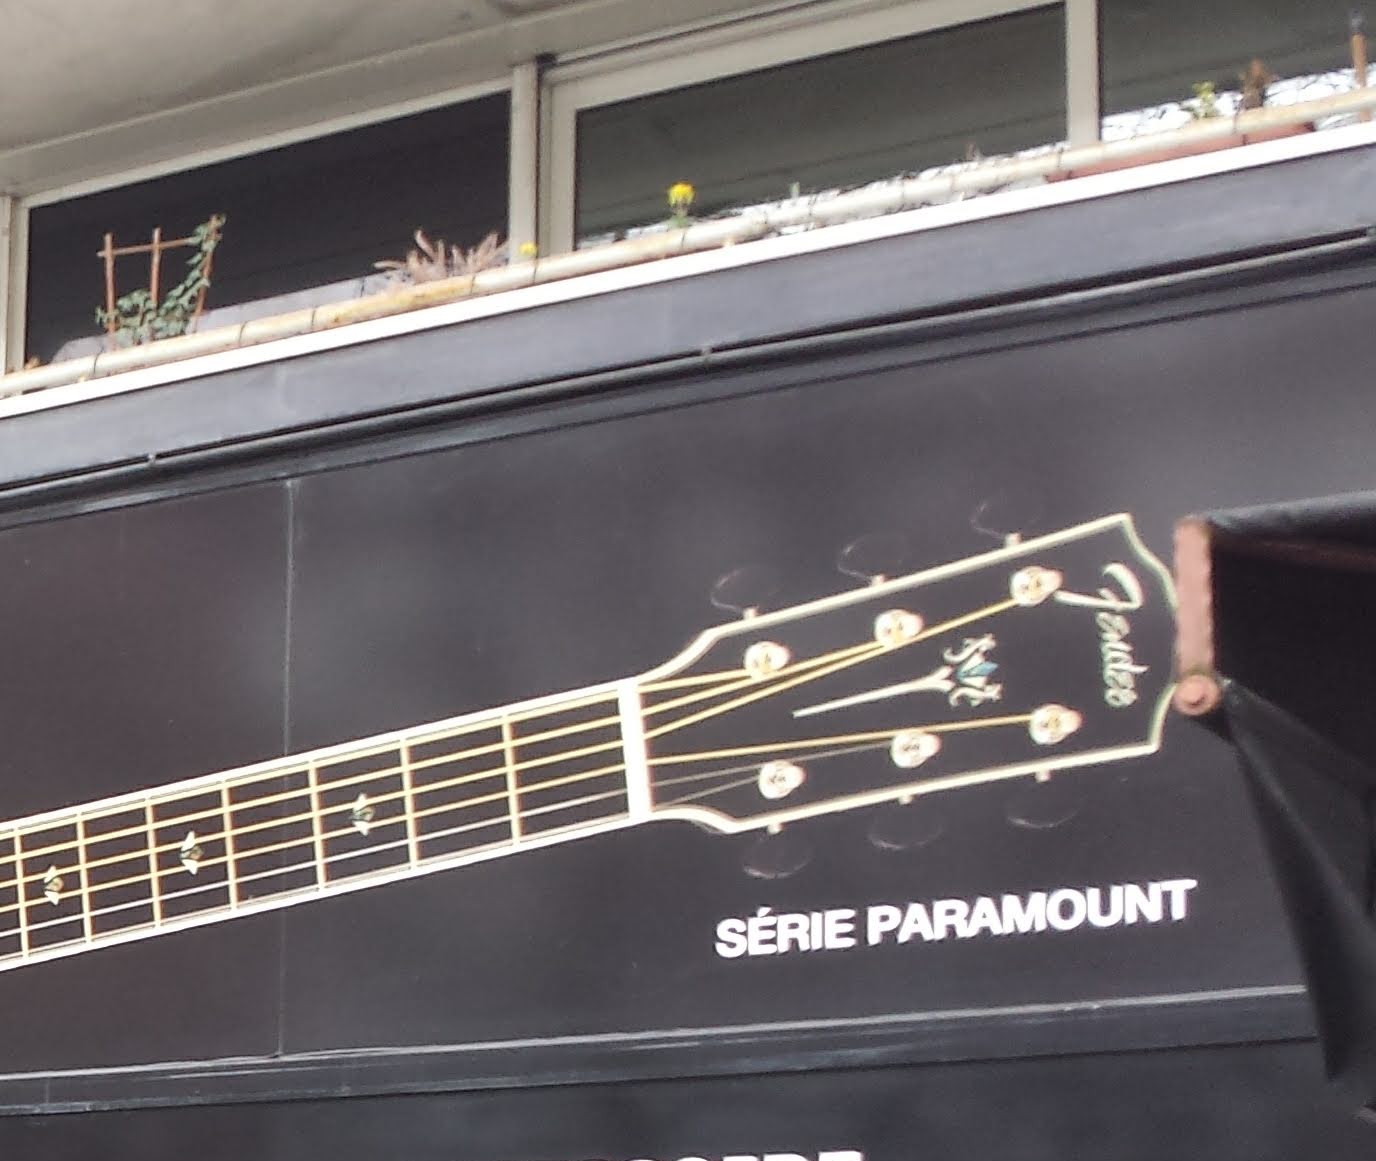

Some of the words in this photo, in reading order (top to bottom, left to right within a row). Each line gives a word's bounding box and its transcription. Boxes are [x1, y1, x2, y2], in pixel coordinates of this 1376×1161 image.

[1054, 561, 1149, 708] Fender
[715, 906, 857, 958] SÉRIE
[867, 878, 1198, 946] PARAMOUNT
